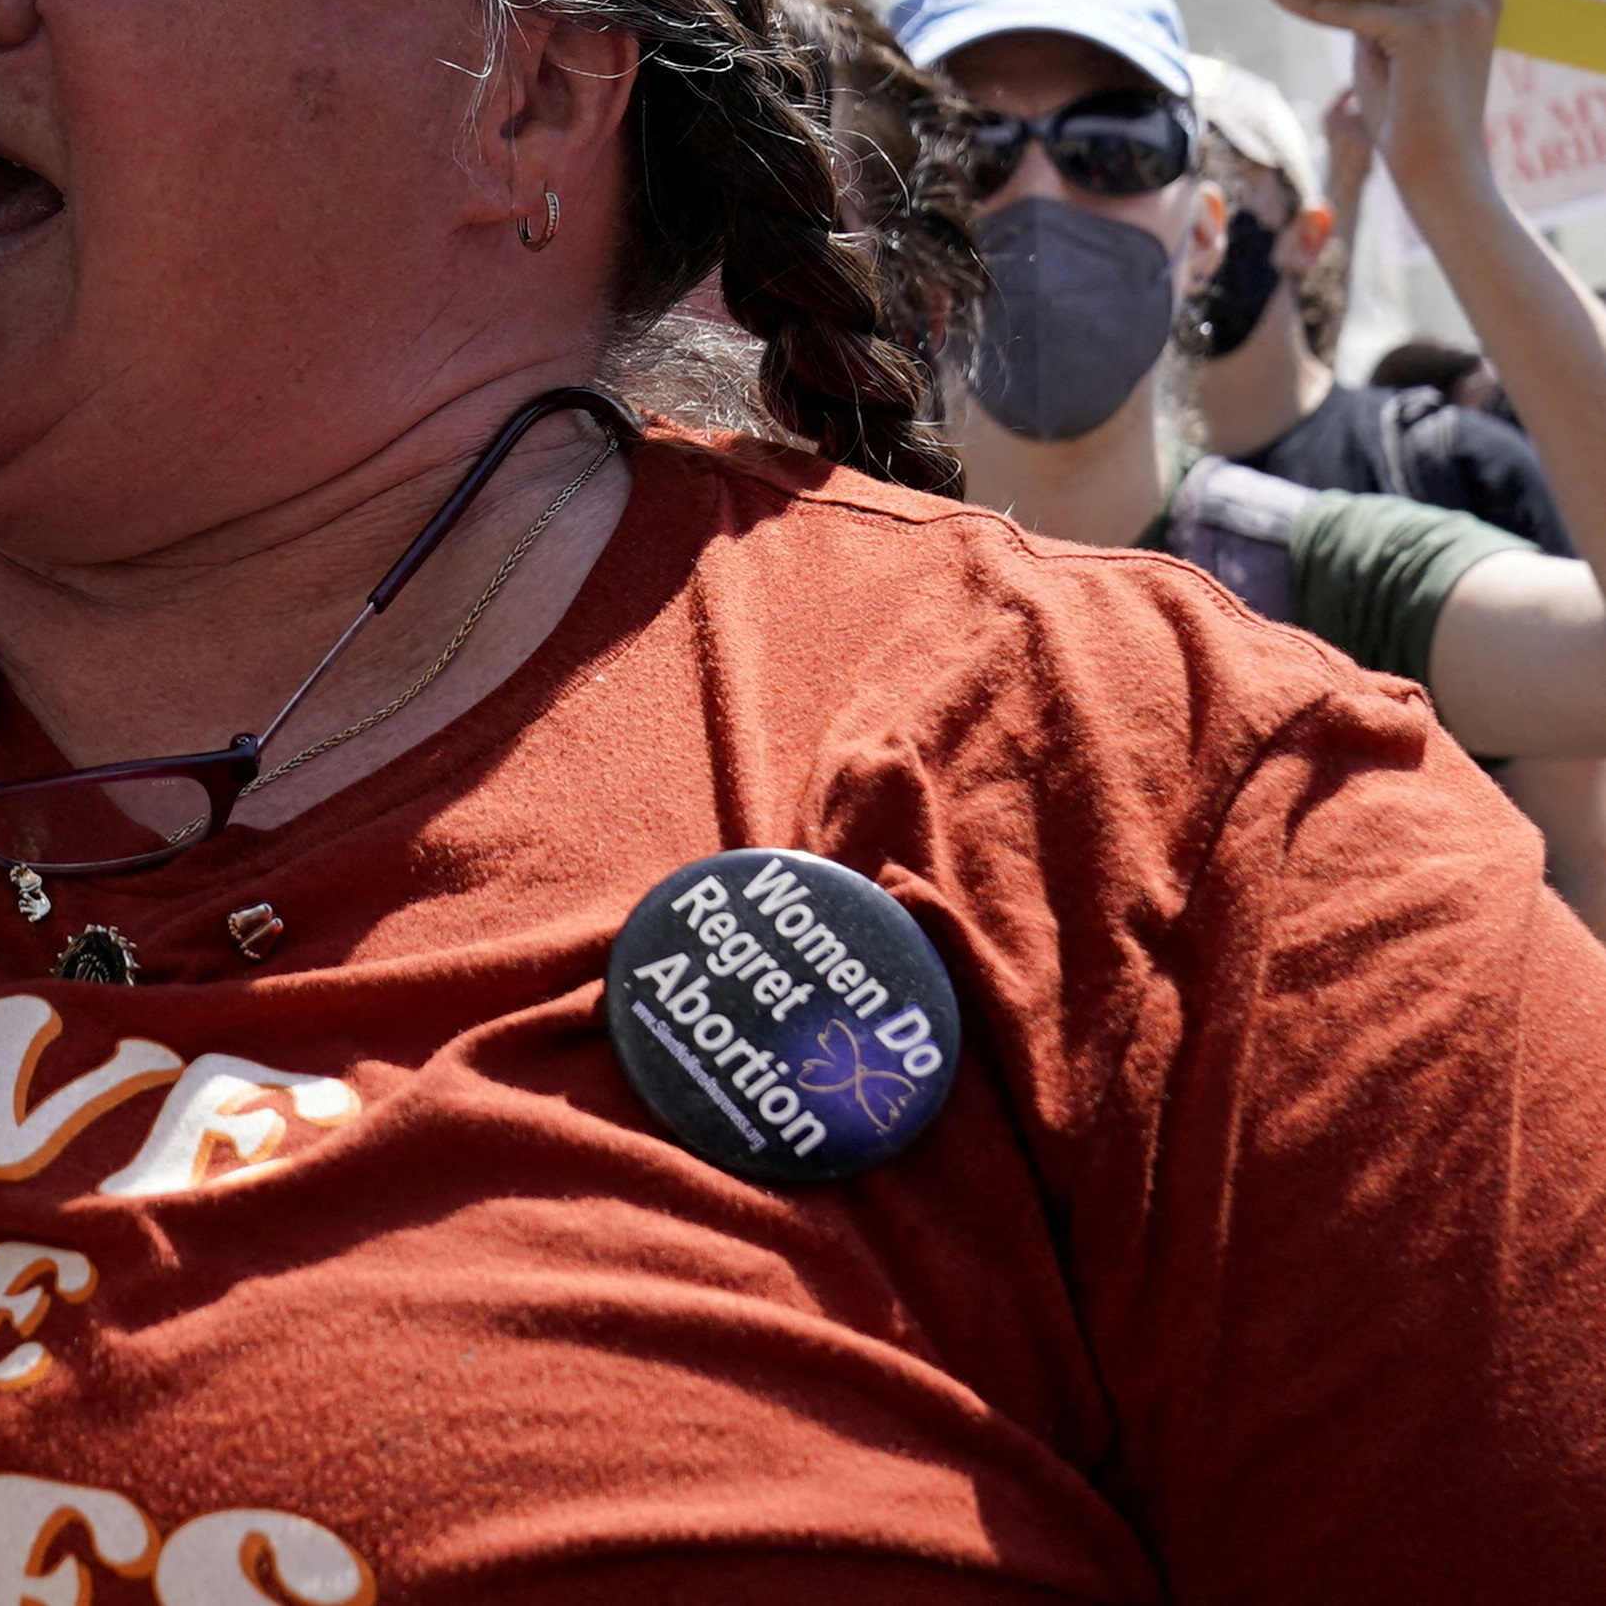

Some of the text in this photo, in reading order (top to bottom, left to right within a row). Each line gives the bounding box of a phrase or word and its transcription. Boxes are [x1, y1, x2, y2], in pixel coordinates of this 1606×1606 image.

[670, 874, 817, 1024] Regret
[741, 856, 945, 1079] Women Do
[633, 951, 829, 1160] Abortion
